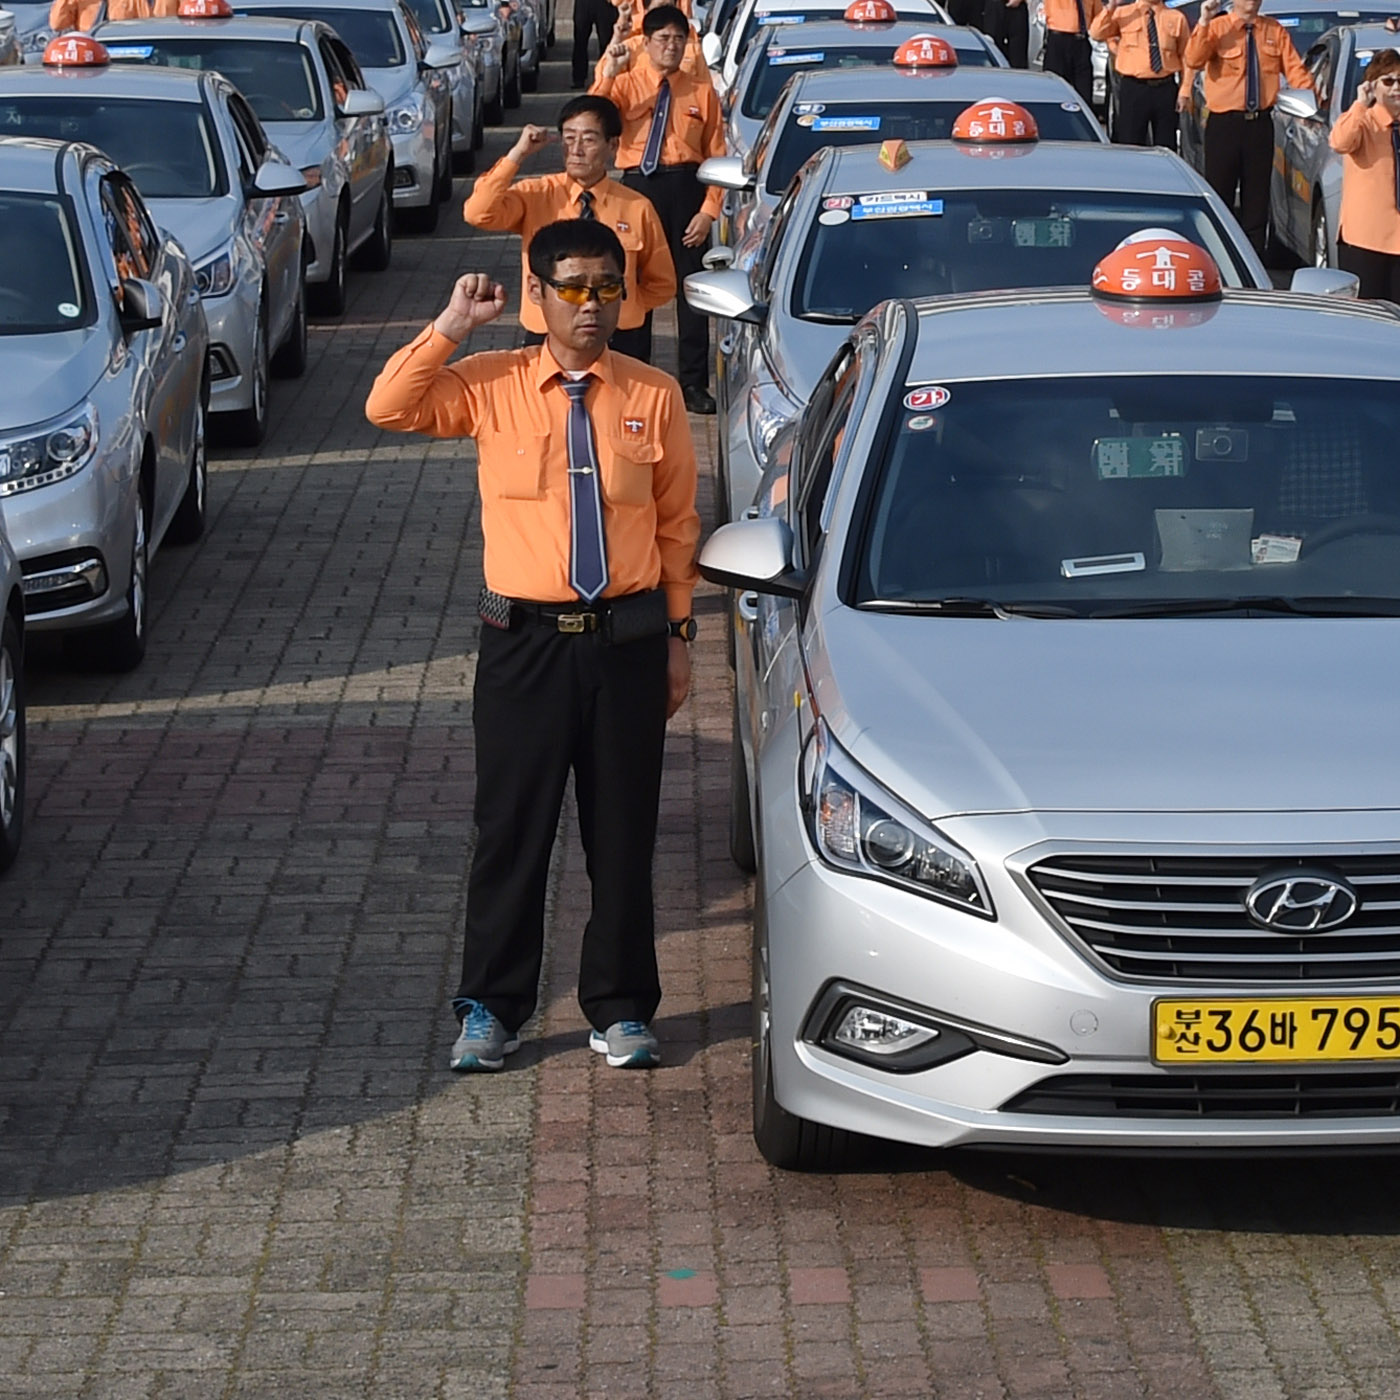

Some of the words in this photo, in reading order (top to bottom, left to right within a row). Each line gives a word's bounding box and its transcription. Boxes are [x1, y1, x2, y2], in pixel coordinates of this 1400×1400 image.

[1121, 268, 1205, 292] 등대콜
[1174, 1009, 1202, 1053] 부산
[1205, 1009, 1298, 1053] 36바
